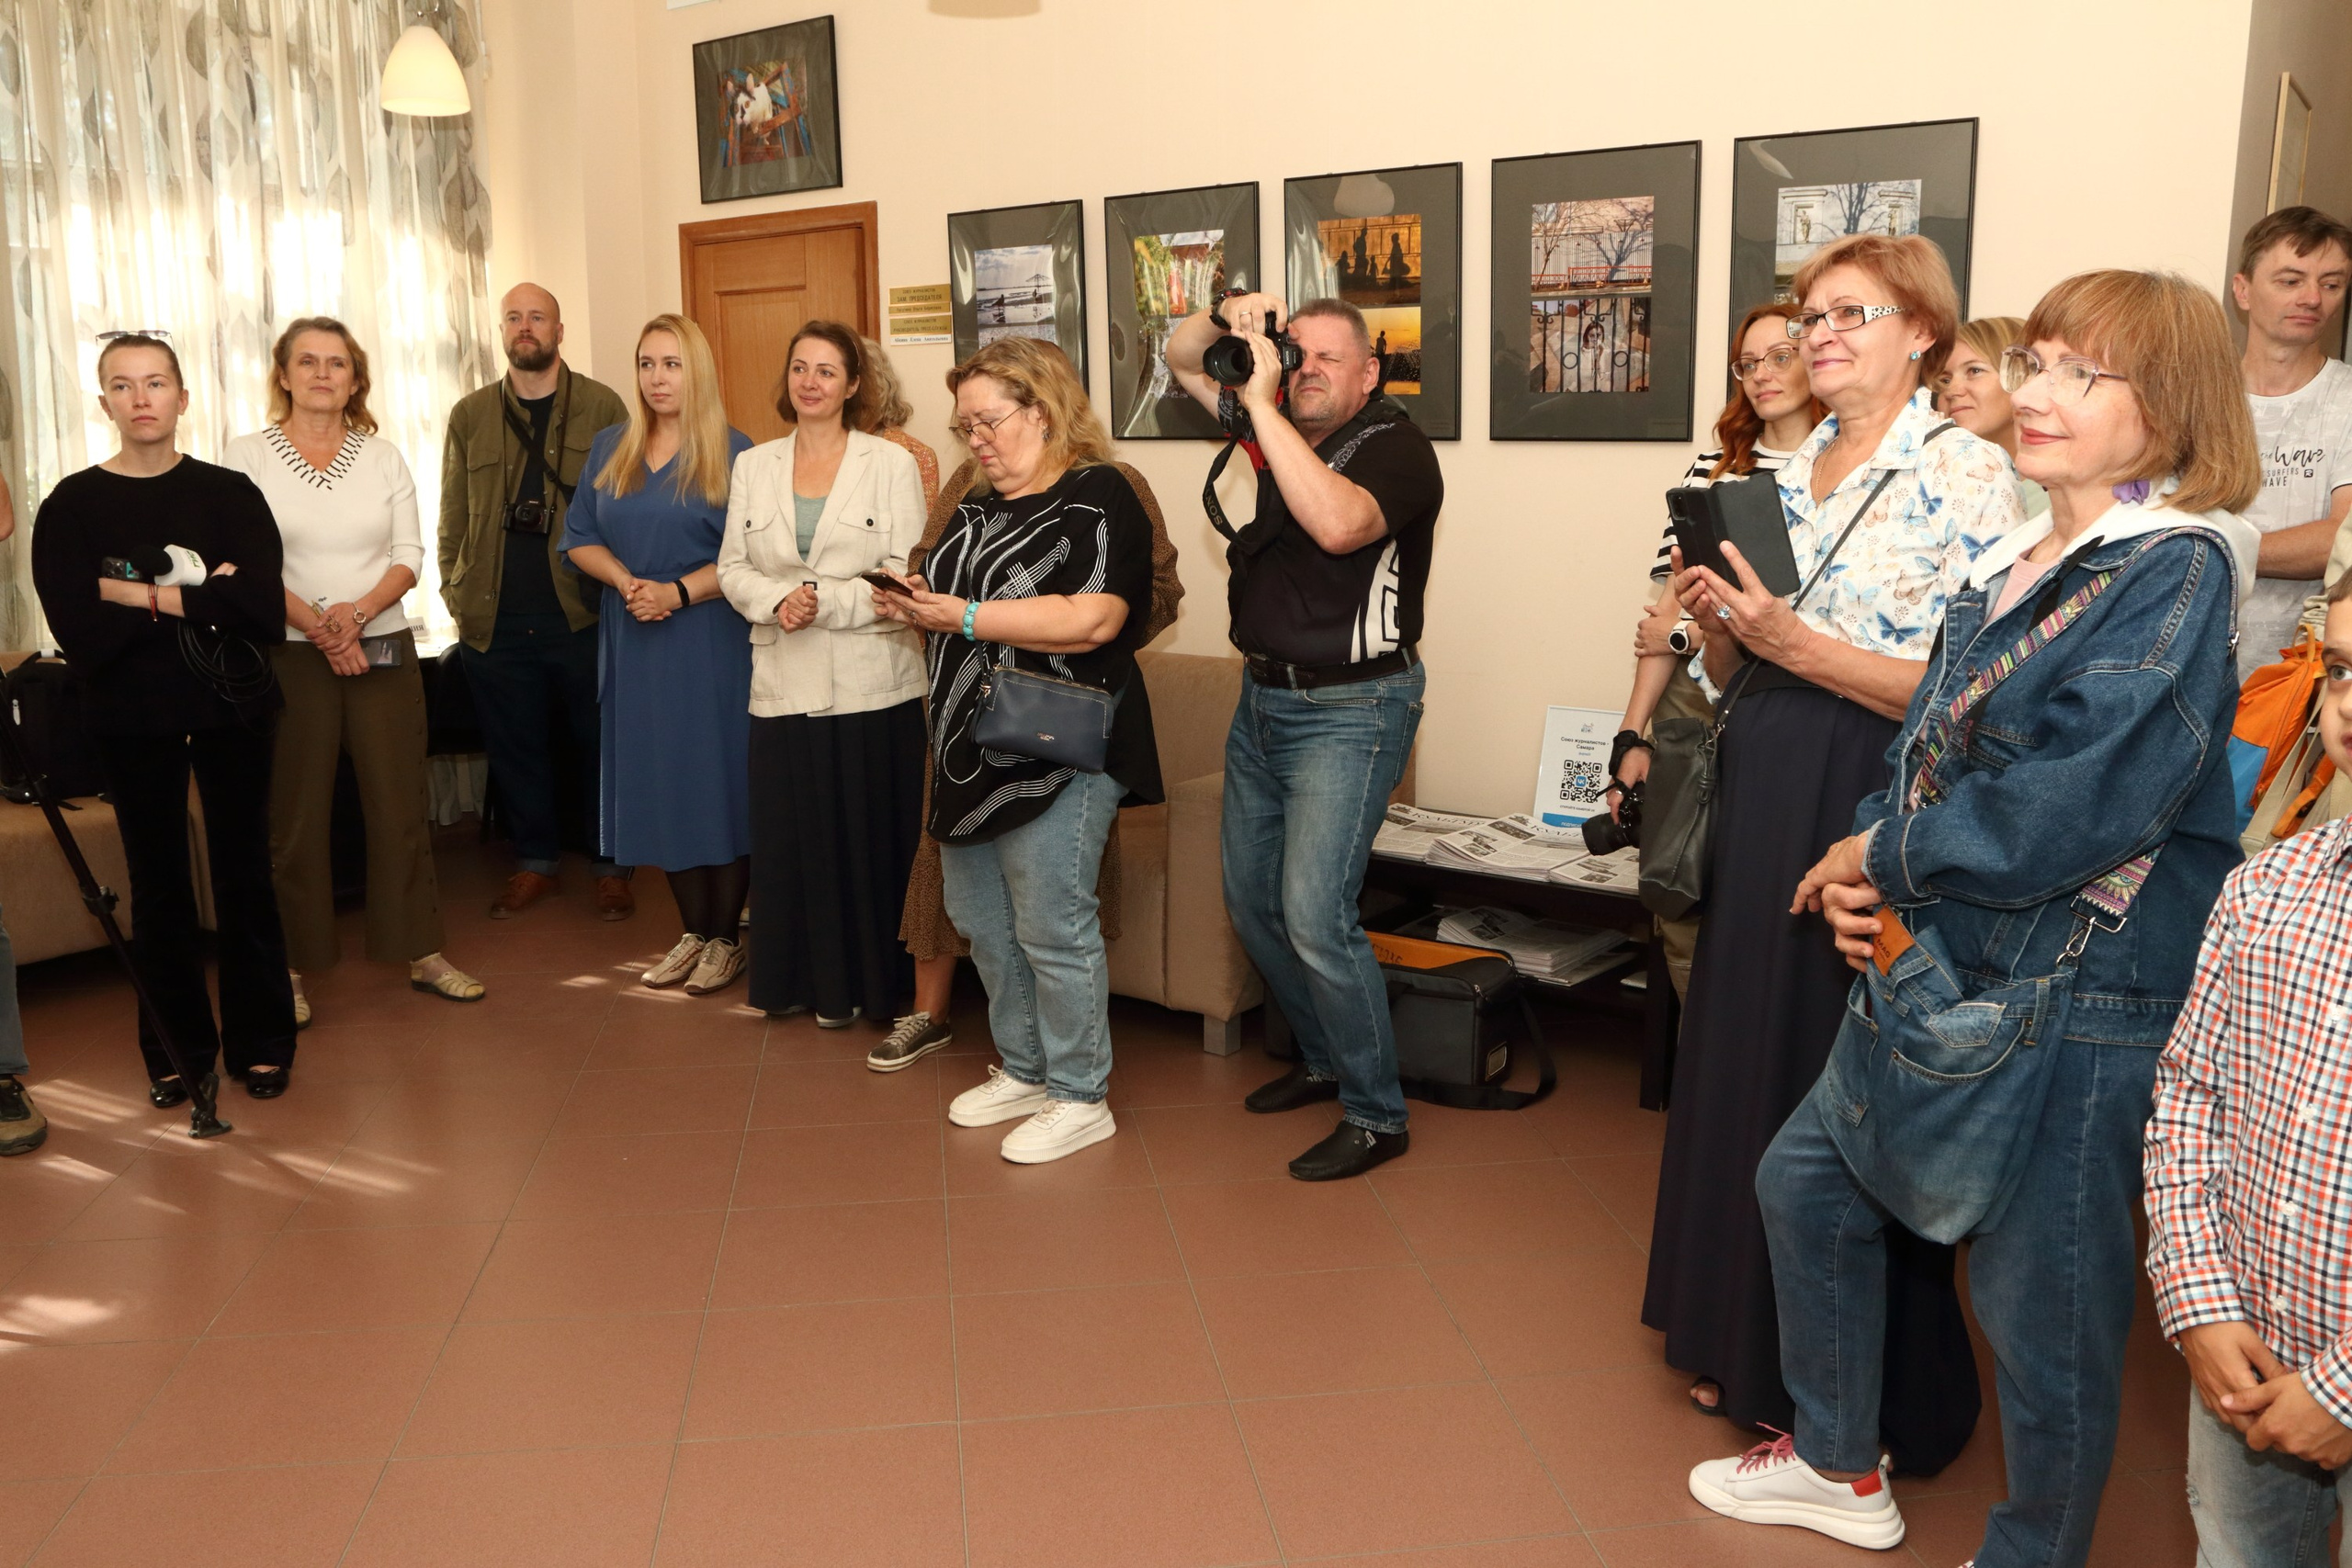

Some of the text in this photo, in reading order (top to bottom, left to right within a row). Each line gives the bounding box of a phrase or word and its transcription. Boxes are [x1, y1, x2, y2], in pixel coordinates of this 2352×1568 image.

[2275, 446, 2326, 468] Wave
[2267, 468, 2300, 478] SURFERS
[1530, 825, 1583, 839] КУЛЬТ
